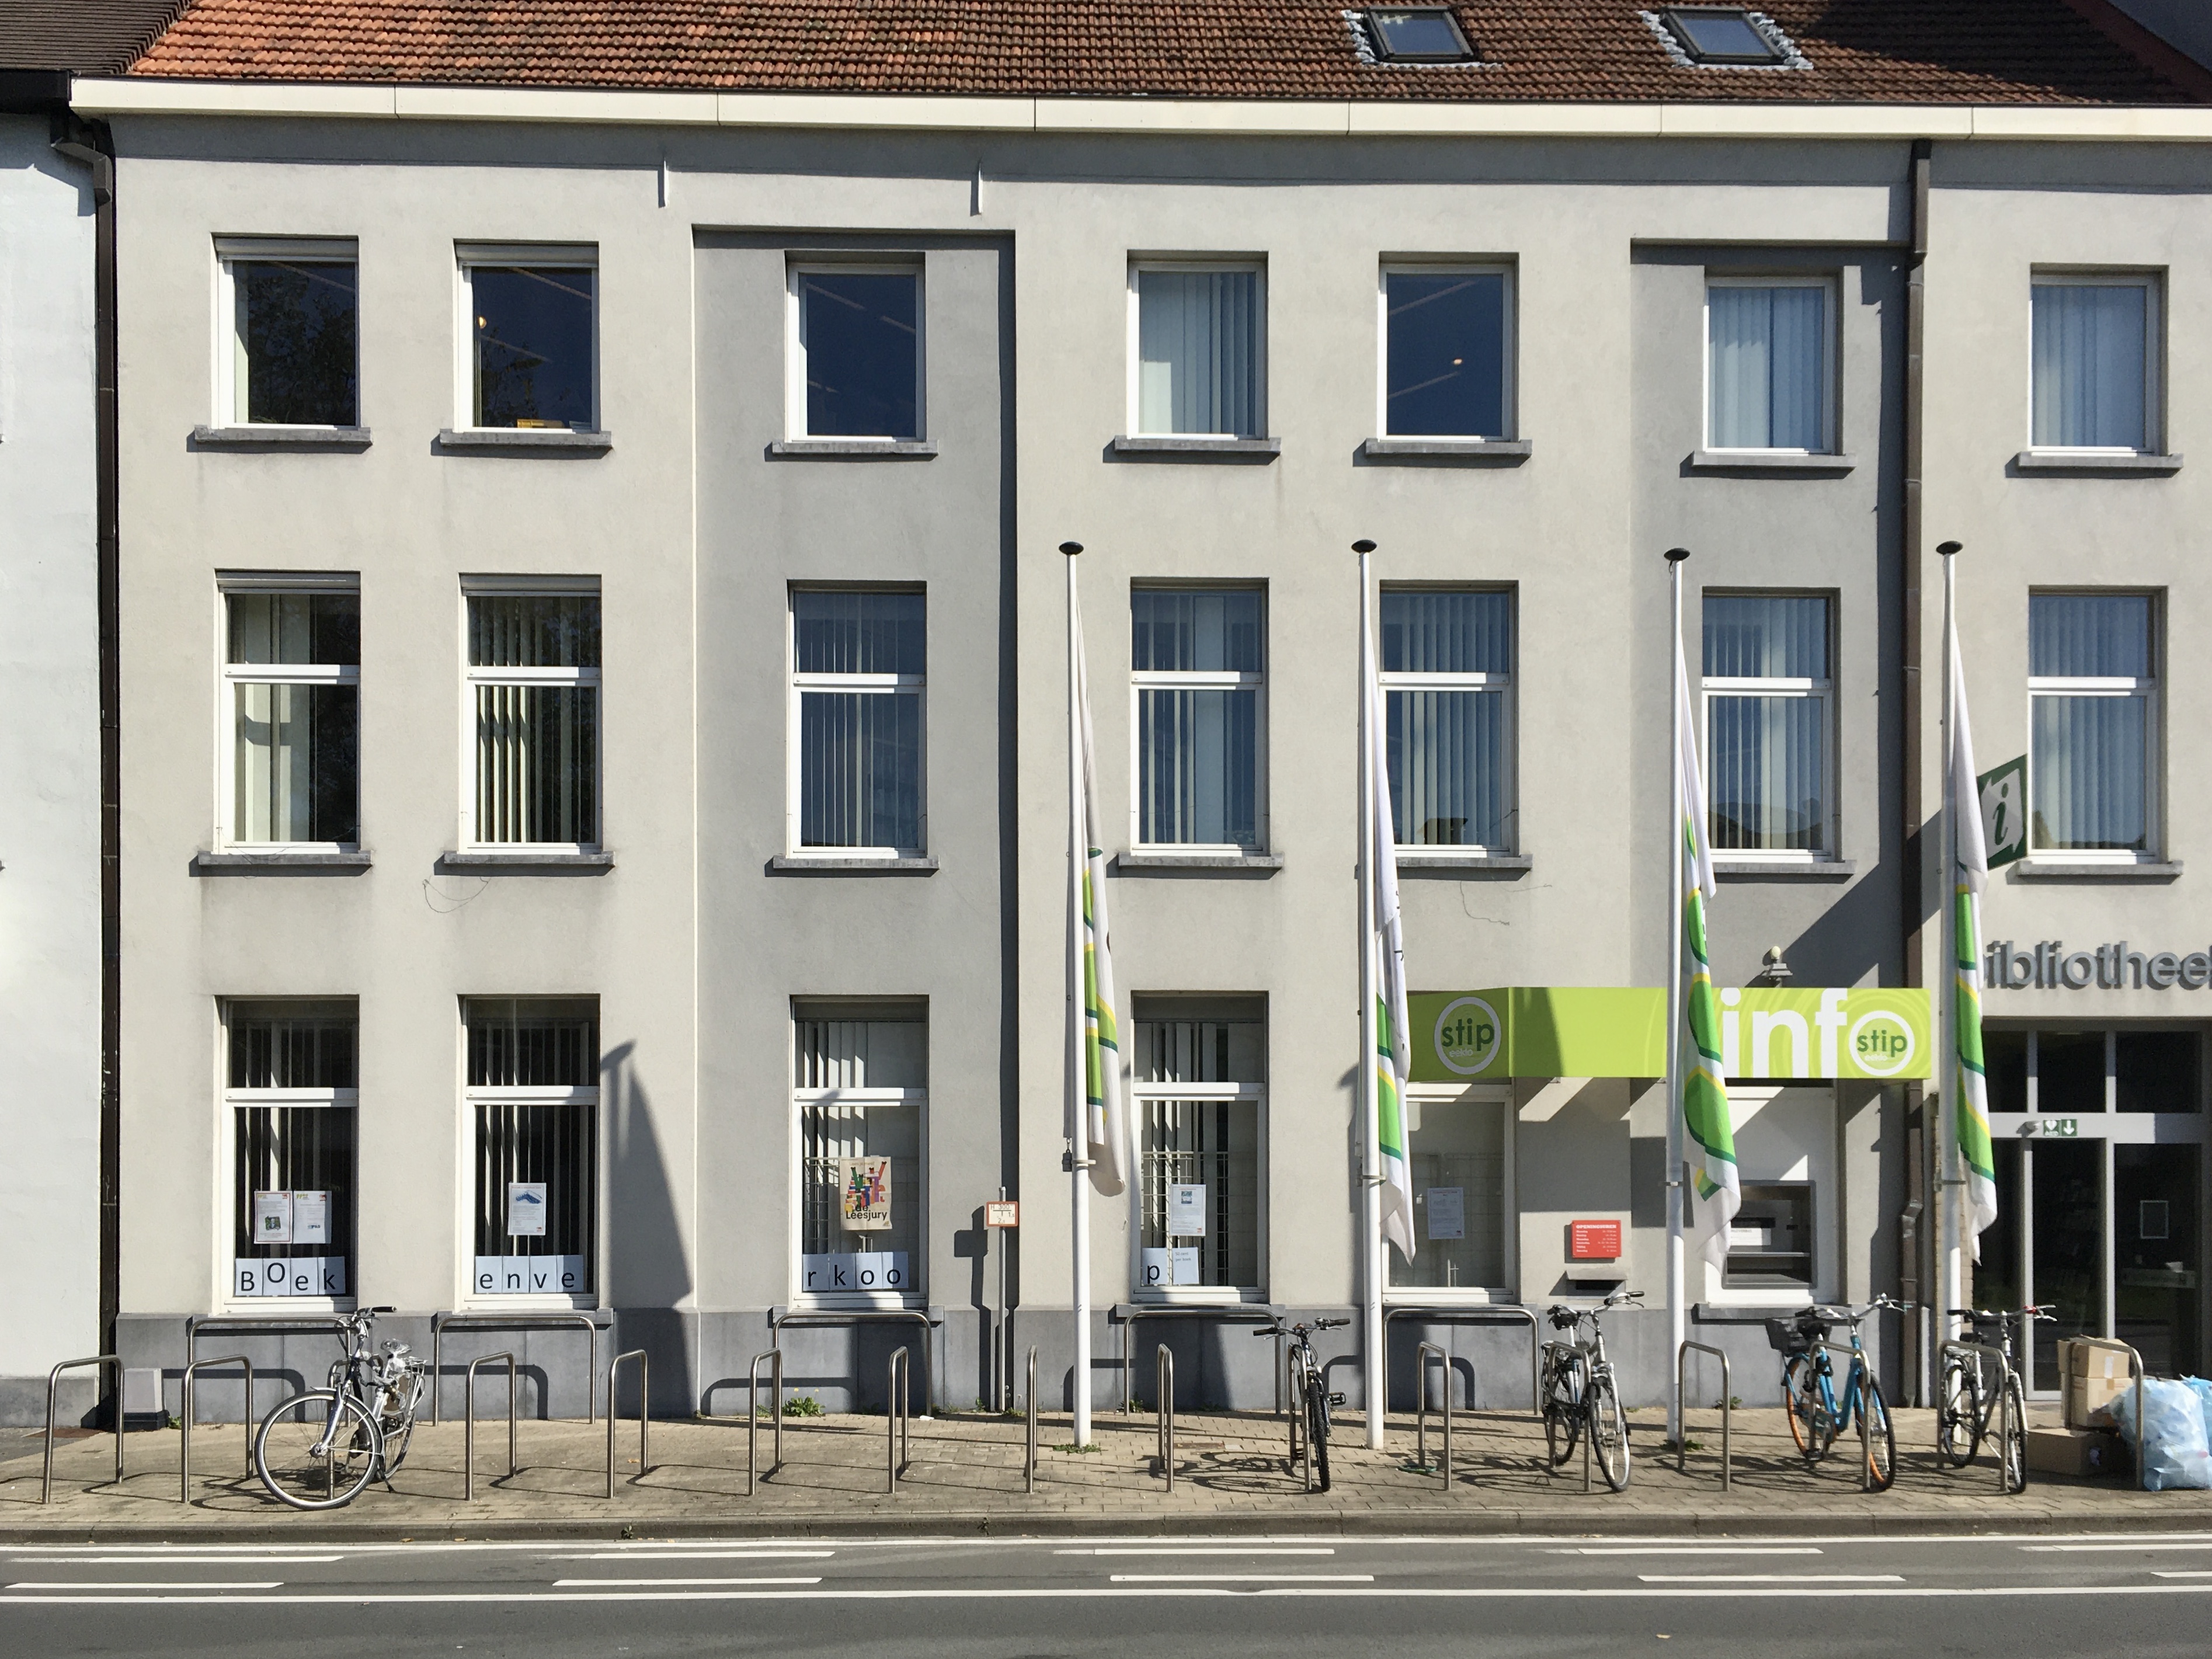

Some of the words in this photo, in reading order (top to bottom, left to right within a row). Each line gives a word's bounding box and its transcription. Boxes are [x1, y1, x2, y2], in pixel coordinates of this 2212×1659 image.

[1984, 940, 2212, 986] ibliothee
[1441, 1017, 1495, 1051] stip
[1857, 1030, 1908, 1058] stip
[846, 1209, 888, 1222] Leesjury
[479, 1271, 575, 1289] enve
[808, 1264, 901, 1286] rkoo
[1147, 1264, 1160, 1285] p
